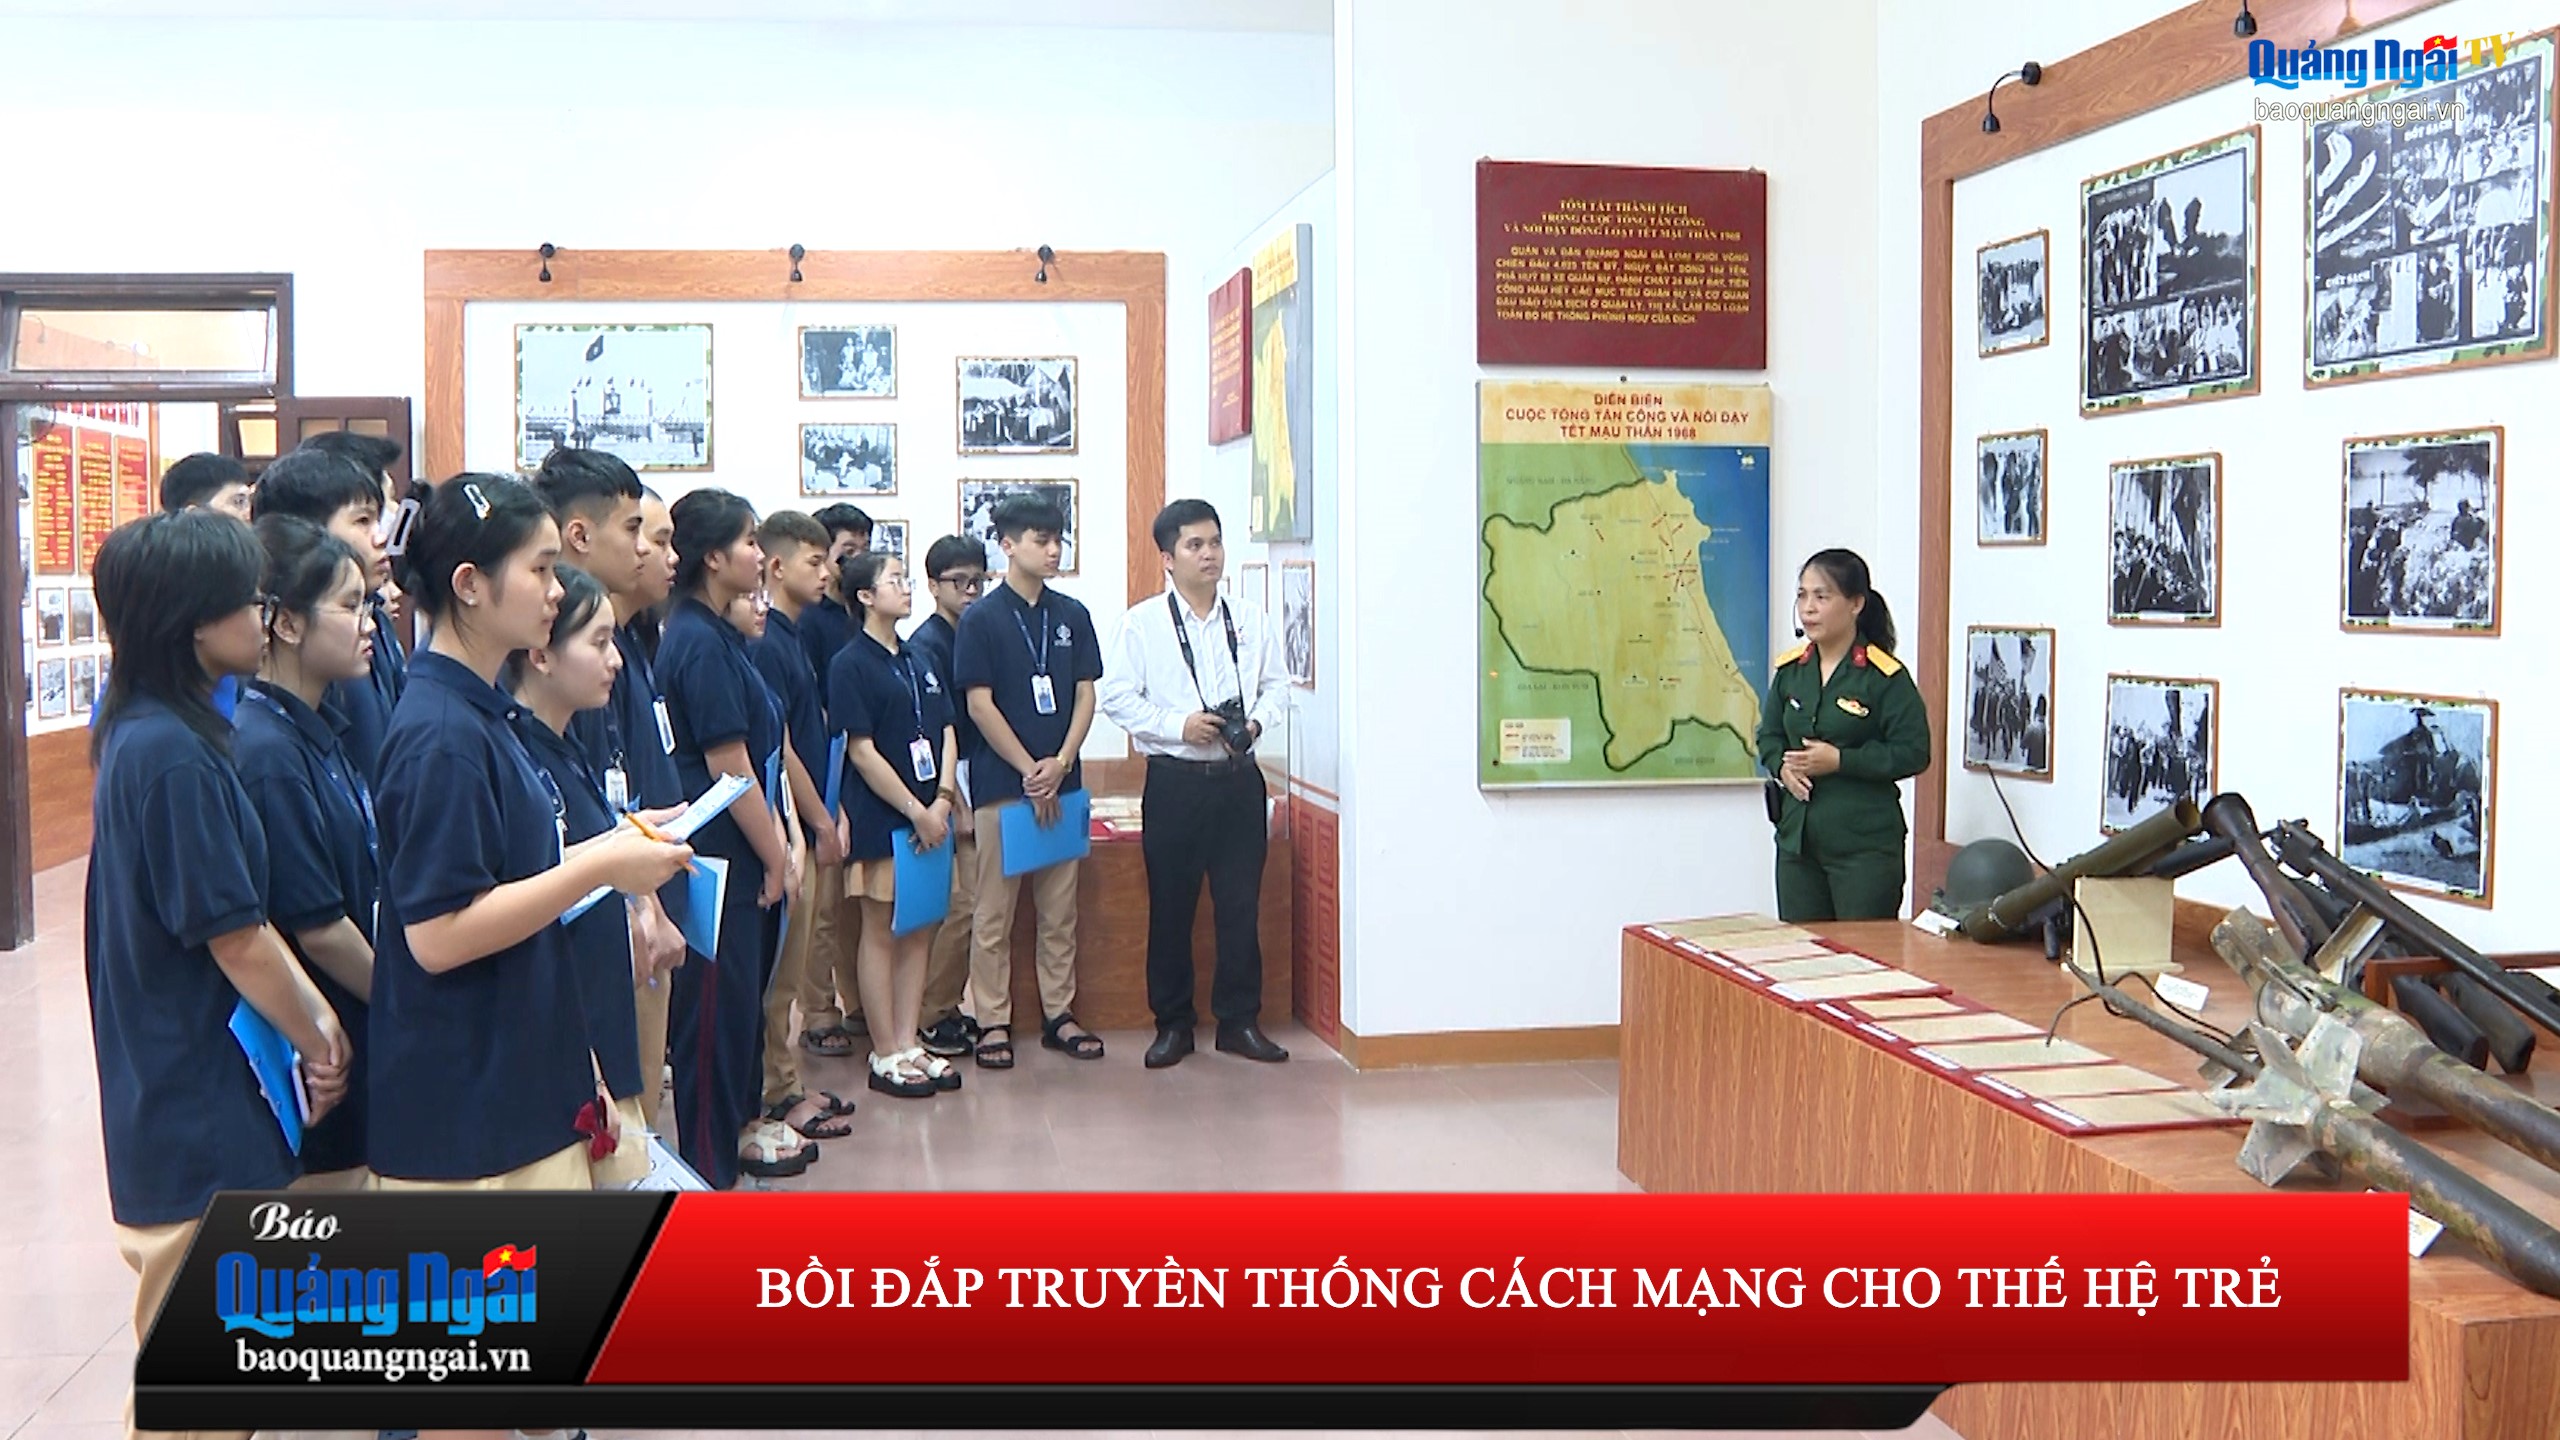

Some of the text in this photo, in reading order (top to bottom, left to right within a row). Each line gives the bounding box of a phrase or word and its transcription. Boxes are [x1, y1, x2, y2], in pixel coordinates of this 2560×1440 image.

[1560, 422, 1697, 440] TẾT MẬU THÂN 1968
